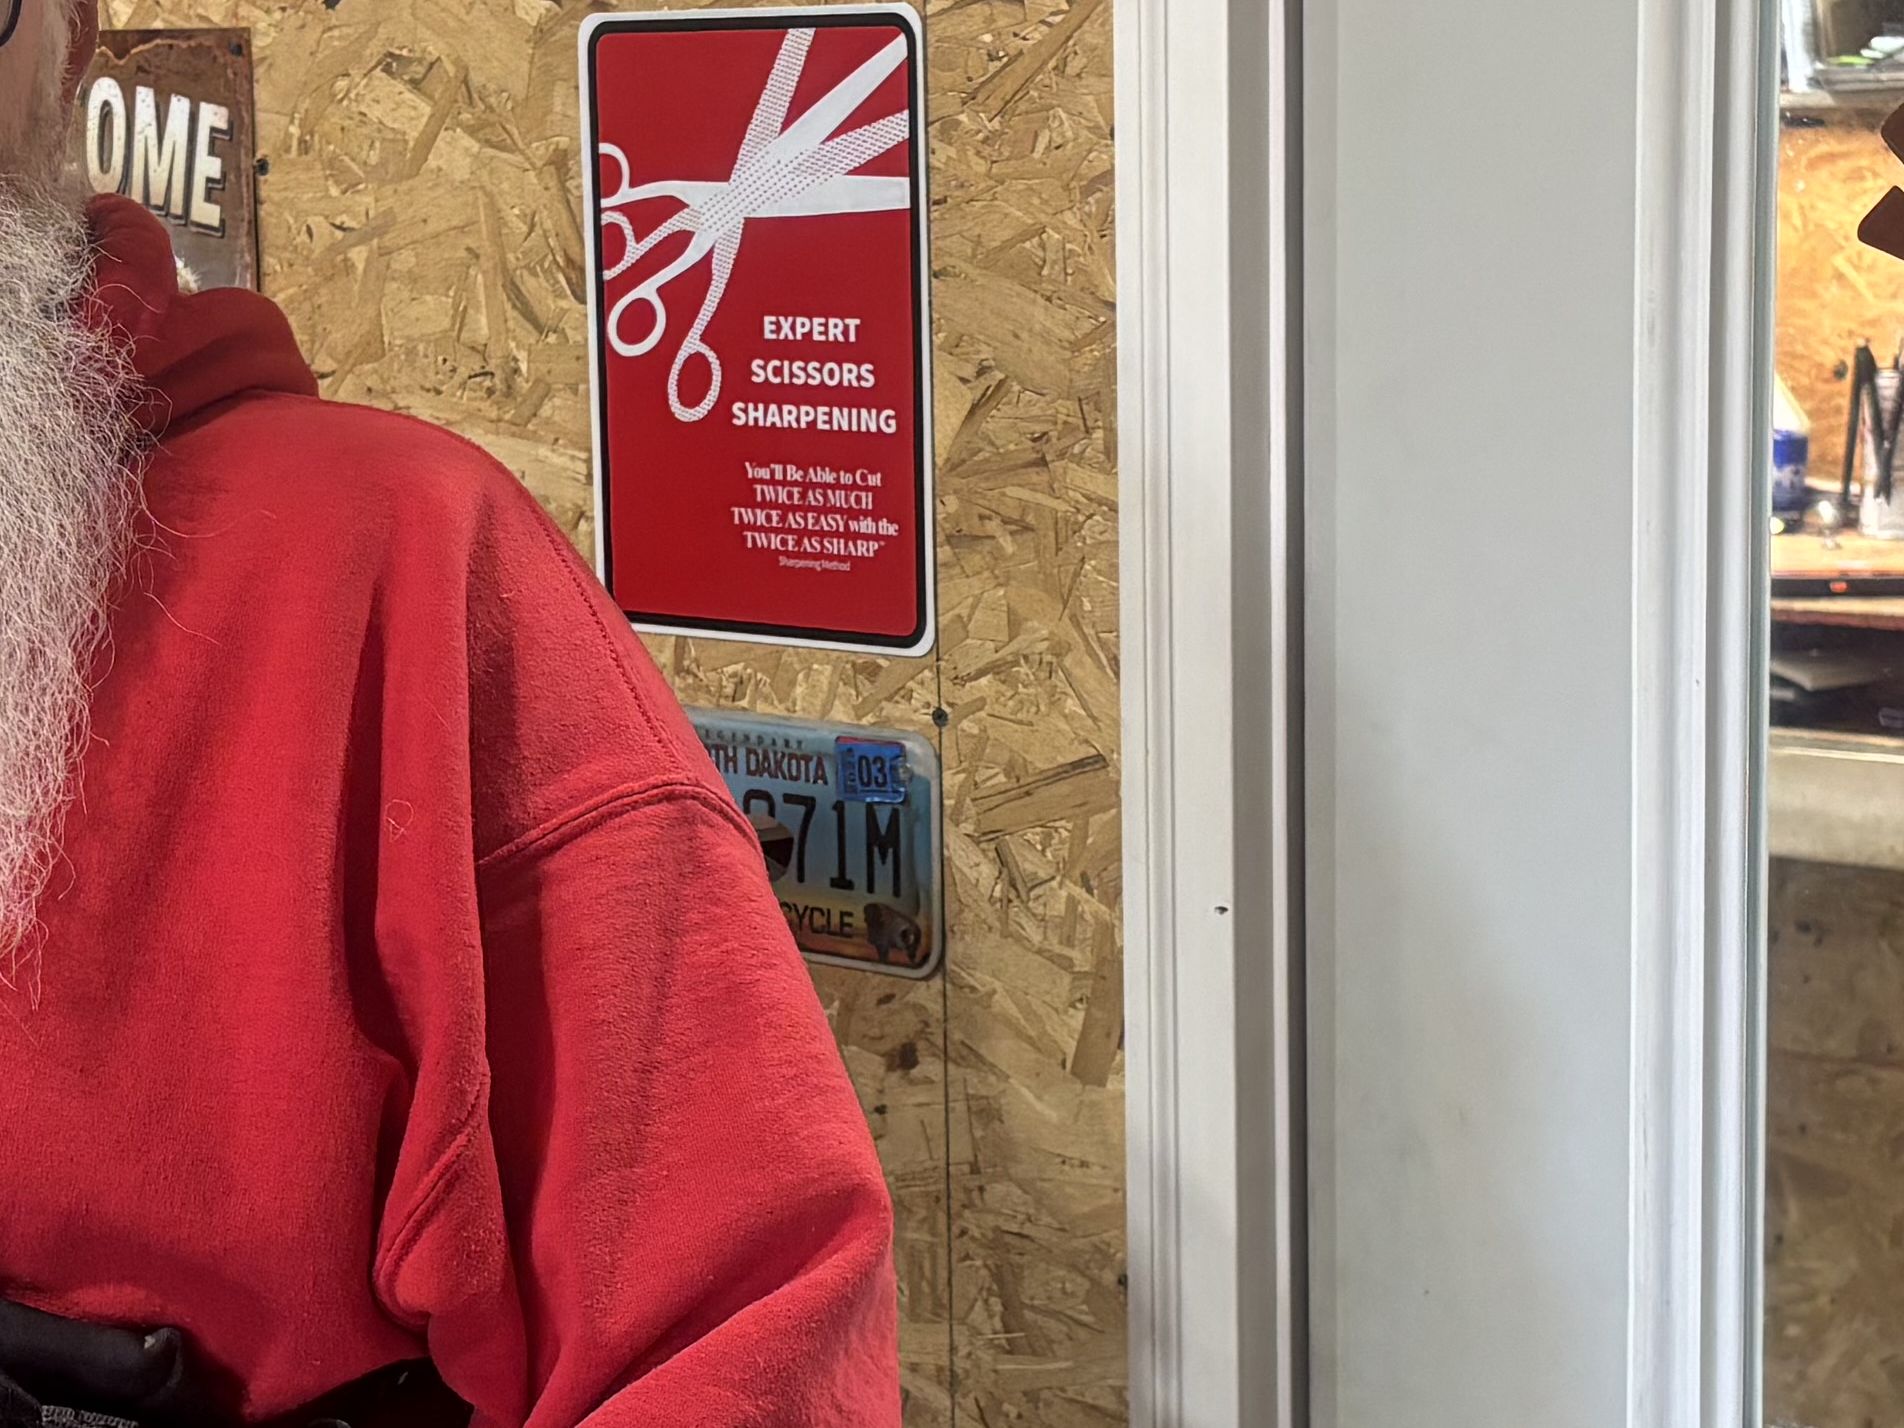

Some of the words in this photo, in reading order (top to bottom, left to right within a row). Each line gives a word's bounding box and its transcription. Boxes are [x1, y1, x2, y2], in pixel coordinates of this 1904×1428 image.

[86, 76, 232, 232] OME
[763, 315, 860, 344] EXPERT
[750, 359, 876, 389] SCISSORS
[731, 401, 896, 434] SHARPENING
[745, 462, 783, 480] You'll
[787, 465, 803, 482] Be
[806, 467, 836, 483] Able
[840, 471, 853, 485] to
[856, 469, 881, 487] Cut
[754, 484, 802, 504] TWICE
[805, 489, 824, 507] AS
[826, 490, 873, 510] MUCH
[731, 508, 782, 527] TWICE
[785, 512, 804, 530] AS
[807, 513, 847, 532] EASY
[848, 516, 876, 534] with
[878, 518, 899, 536] the
[743, 531, 798, 551] TWICE
[800, 536, 820, 553] AS
[779, 556, 821, 571] Sharpening
[821, 560, 850, 571] Method
[746, 747, 828, 786] DAKOTA
[858, 755, 888, 788] 03
